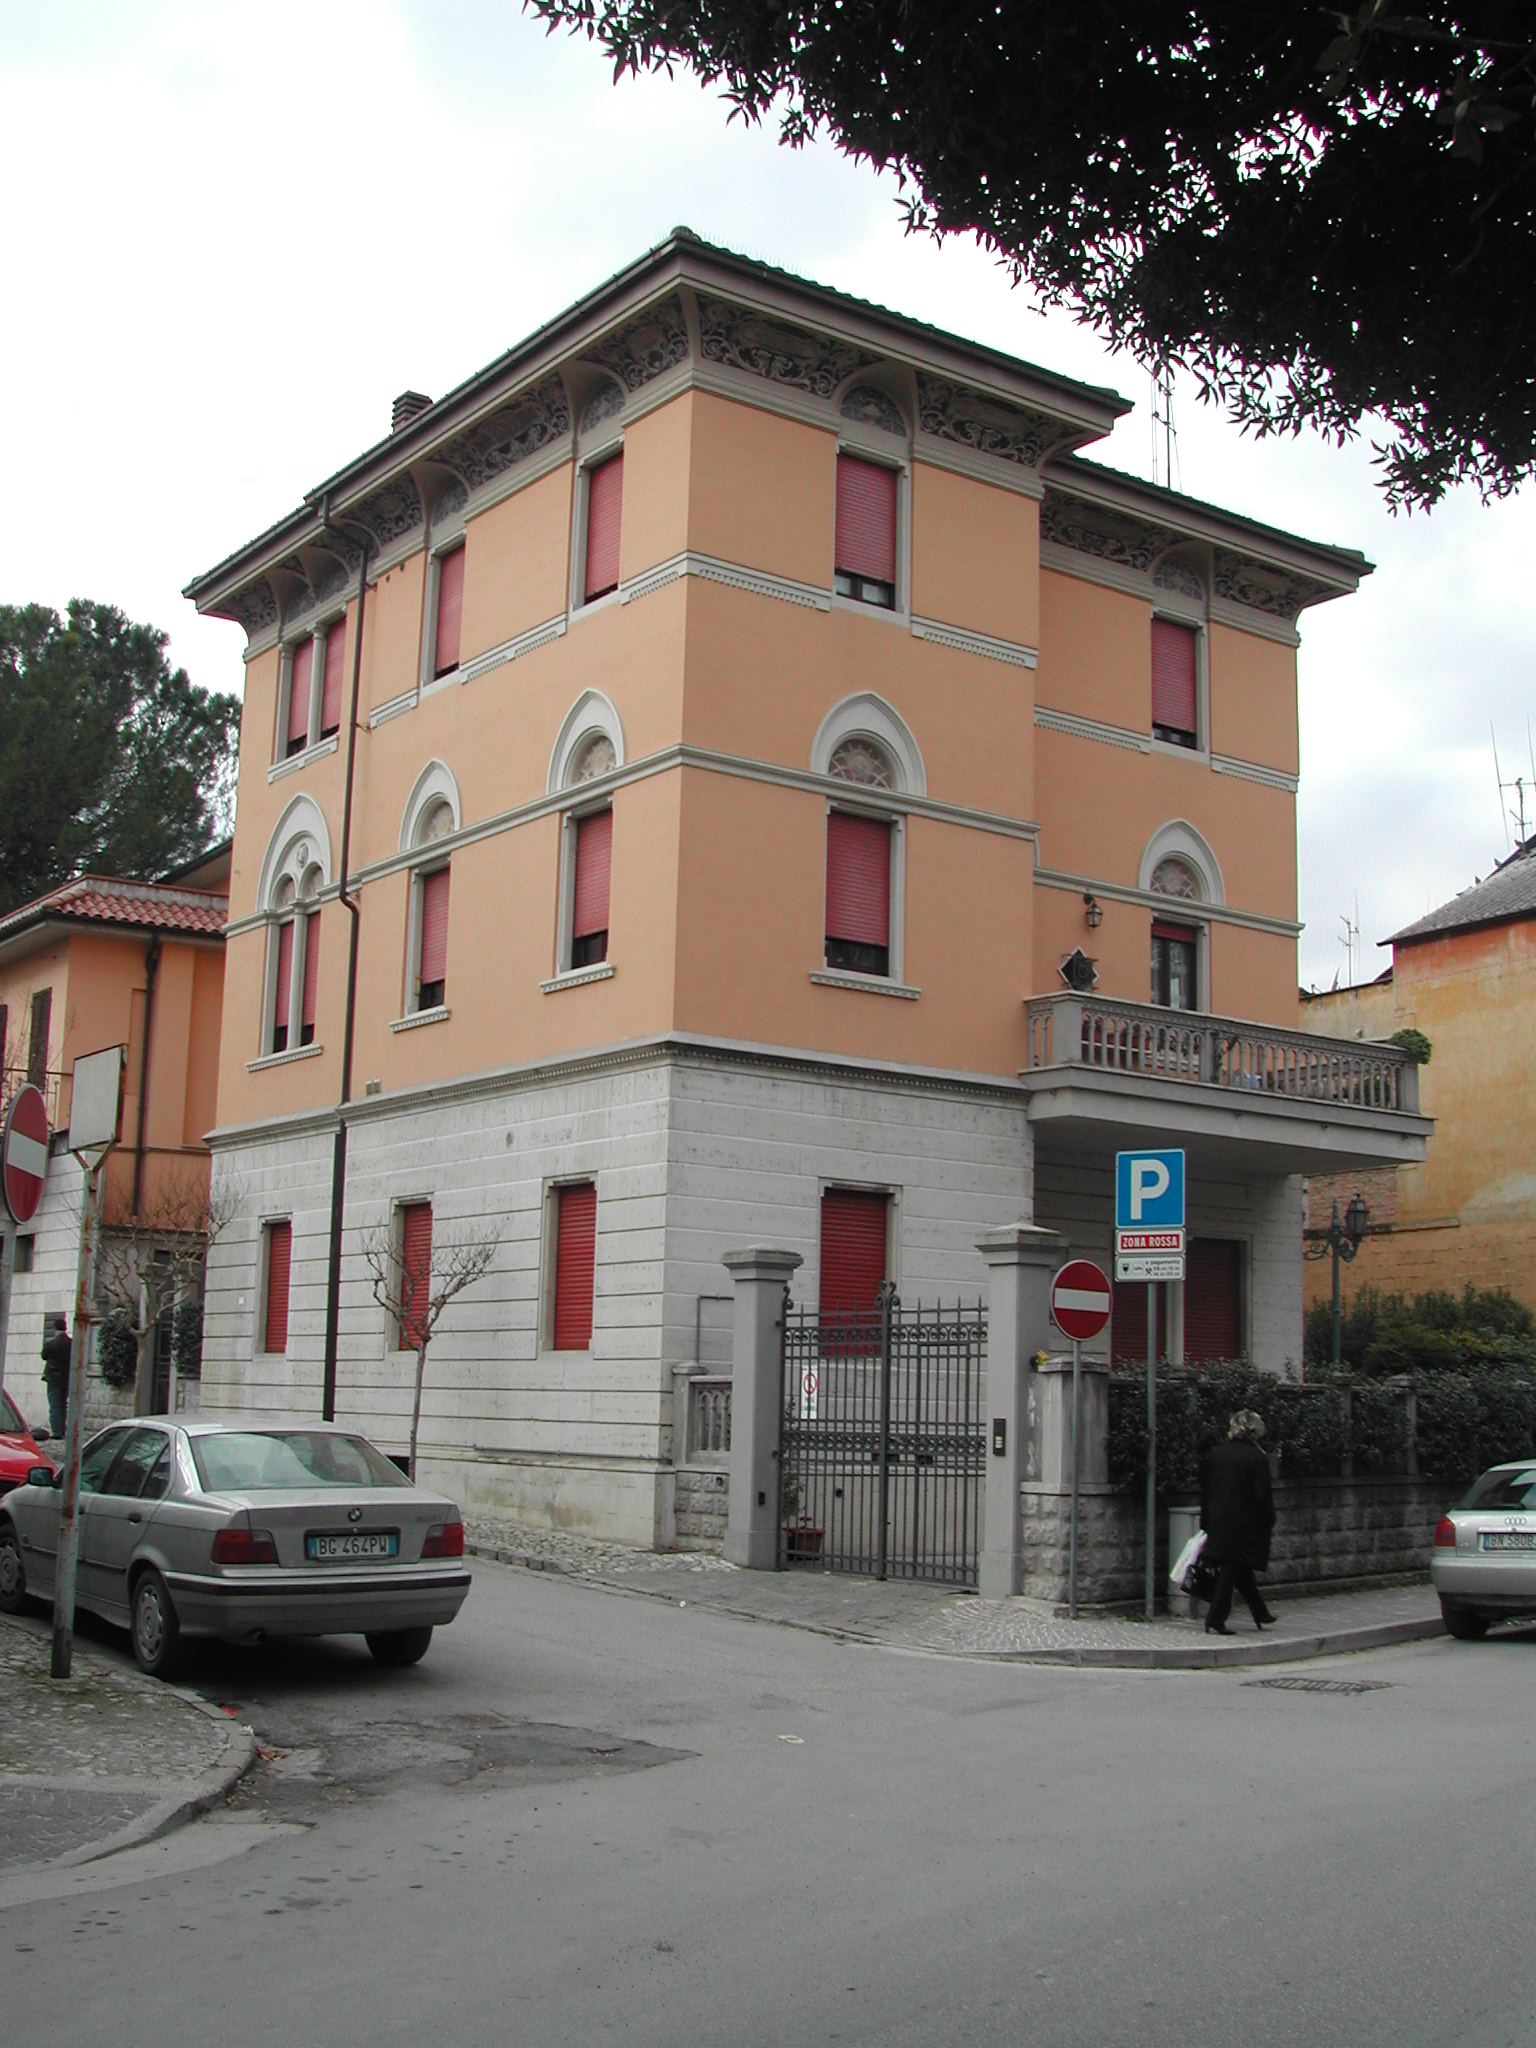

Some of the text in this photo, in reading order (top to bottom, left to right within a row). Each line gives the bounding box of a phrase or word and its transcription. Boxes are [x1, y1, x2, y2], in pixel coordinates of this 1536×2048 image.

[1130, 1159, 1169, 1219] P
[1122, 1235, 1178, 1248] ZONA ROSSA
[319, 1536, 387, 1555] BG 464PW
